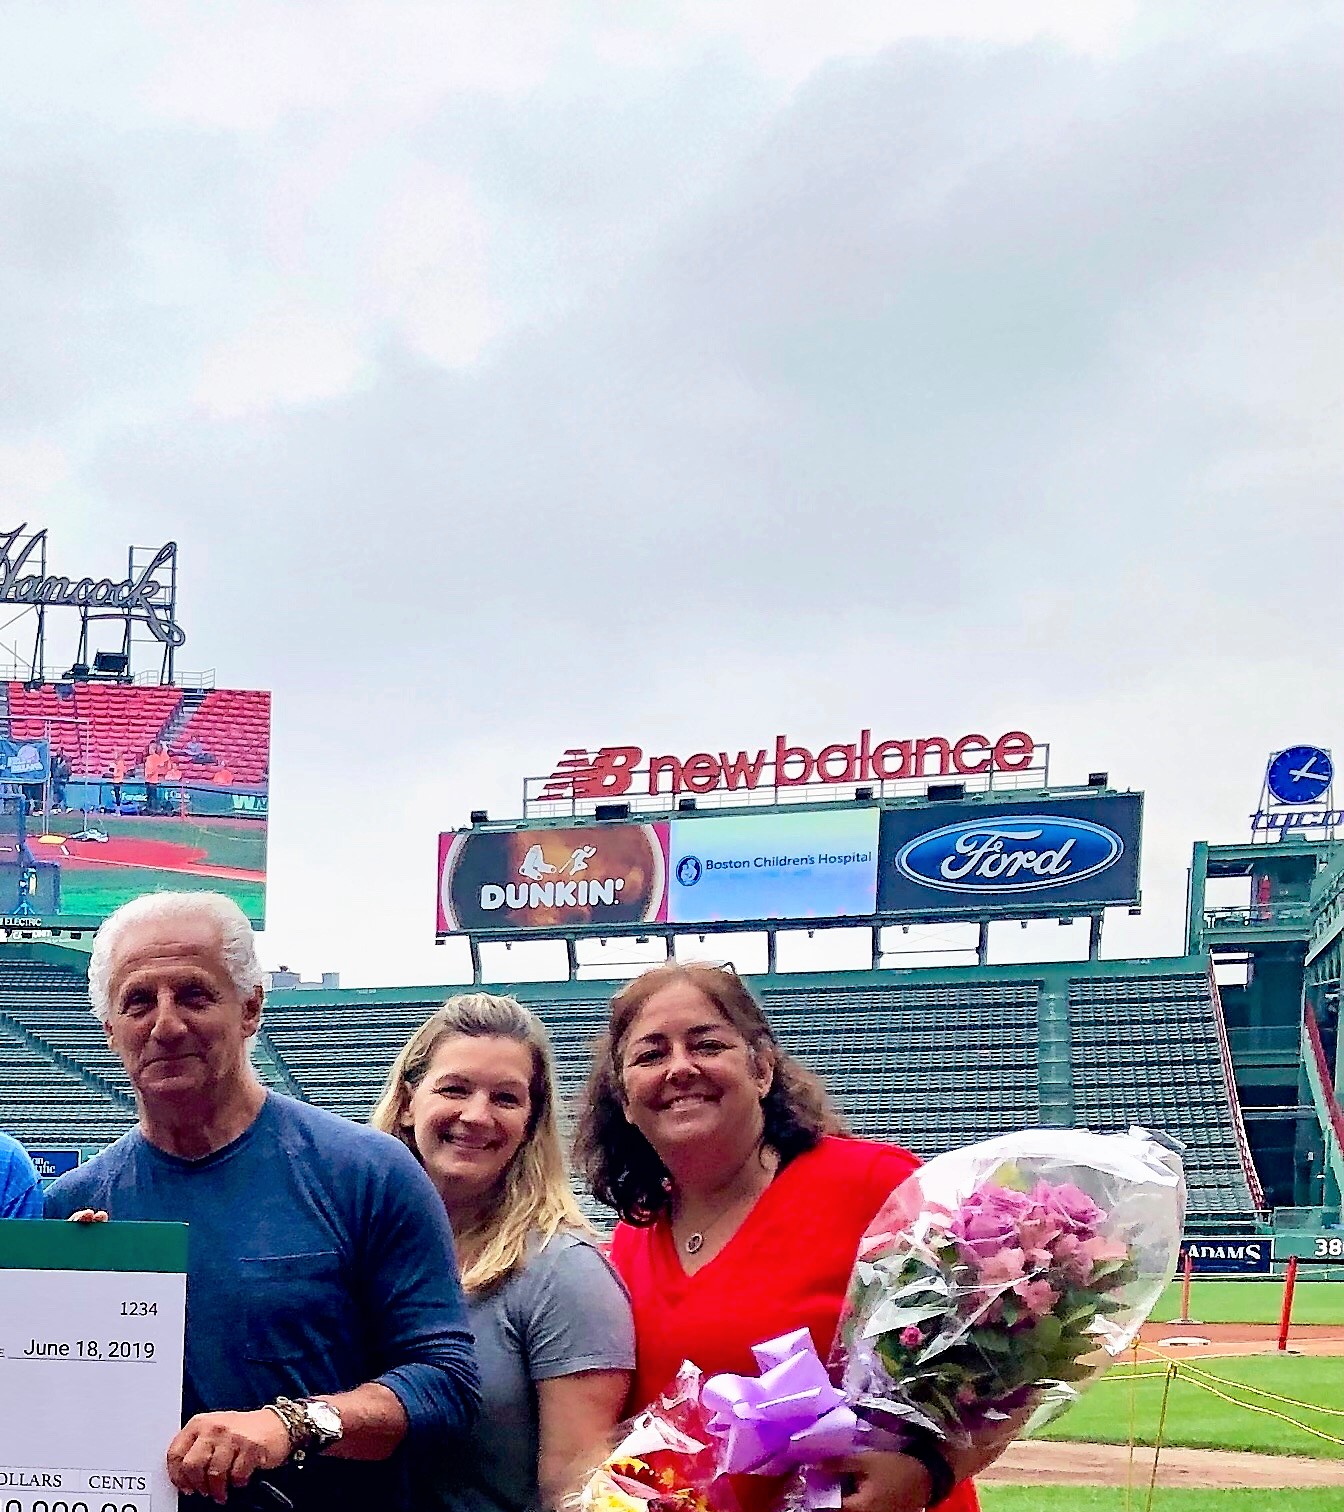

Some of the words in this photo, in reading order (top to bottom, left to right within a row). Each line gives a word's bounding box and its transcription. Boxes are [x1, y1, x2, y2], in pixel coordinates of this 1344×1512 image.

[649, 748, 769, 795] new
[775, 729, 1035, 785] balance
[706, 859, 750, 870] Boston
[753, 854, 815, 868] Children's
[818, 852, 872, 865] Hospital
[940, 829, 1077, 880] Ford
[5, 918, 42, 927] ELECTRIC
[1188, 1244, 1261, 1260] ADAMS
[1314, 1238, 1344, 1257] 38
[120, 1302, 158, 1316] 1234
[23, 1339, 70, 1357] June
[76, 1339, 103, 1360] 18,
[108, 1341, 155, 1359] 2019
[88, 1475, 146, 1491] CENTS
